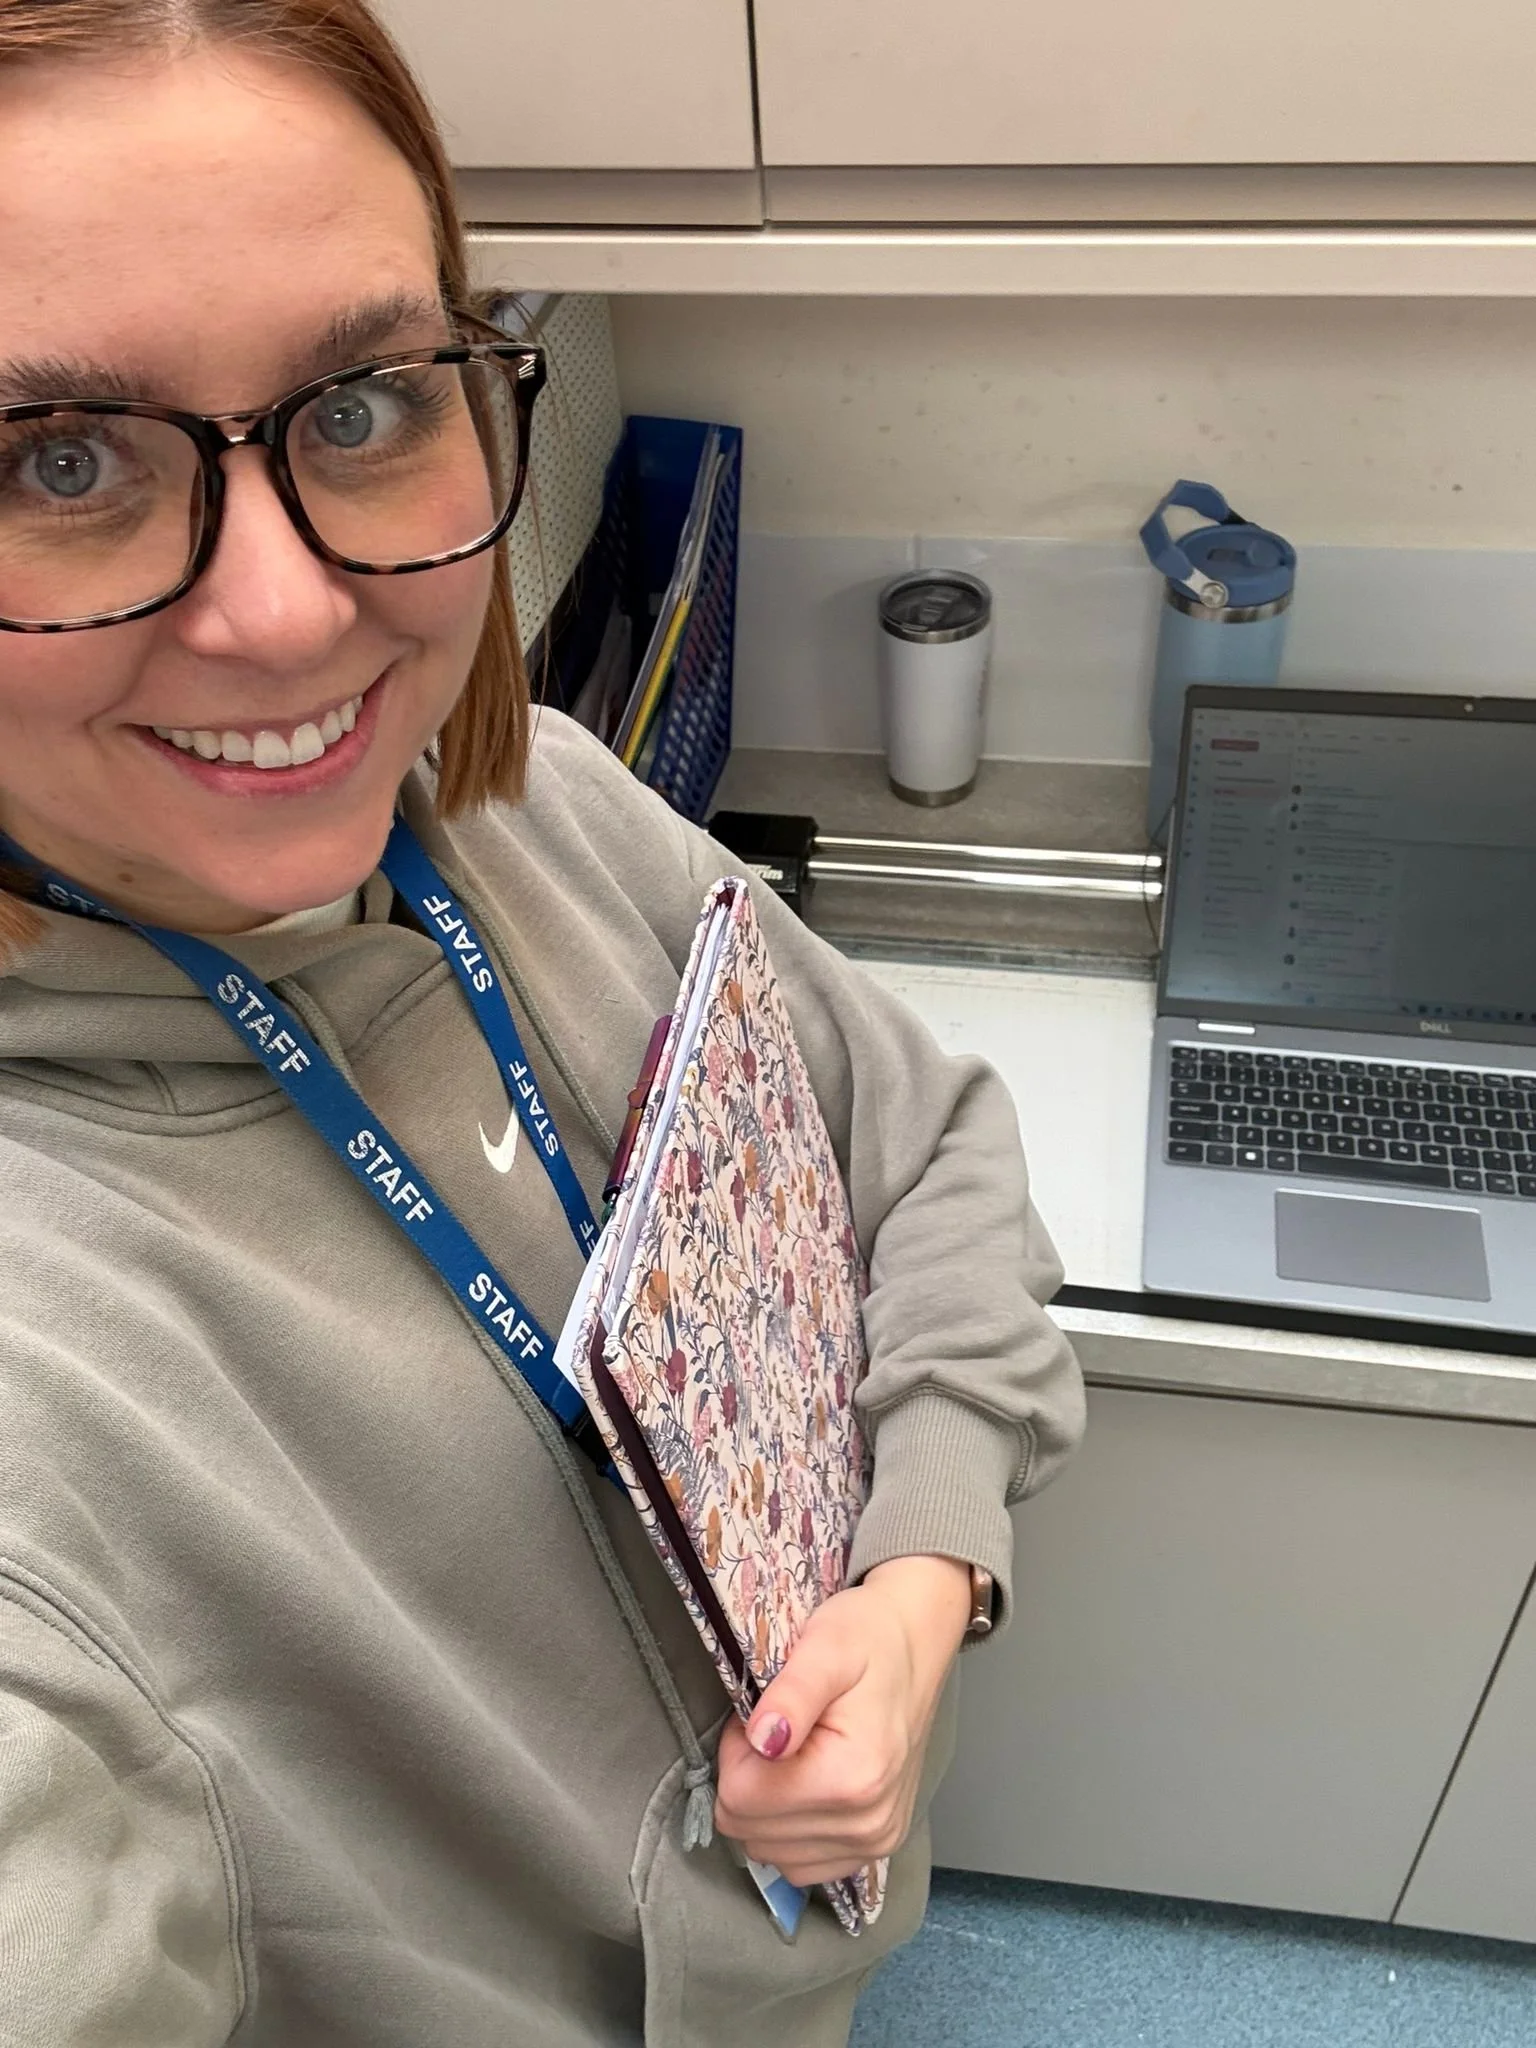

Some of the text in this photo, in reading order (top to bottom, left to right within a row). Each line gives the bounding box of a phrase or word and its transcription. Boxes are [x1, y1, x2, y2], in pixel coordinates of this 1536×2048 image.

[422, 895, 493, 993] STAFF
[217, 973, 311, 1073] STAFF
[509, 1060, 559, 1157] STAFF
[347, 1130, 434, 1222] STAFF
[468, 1272, 544, 1359] STAFF
